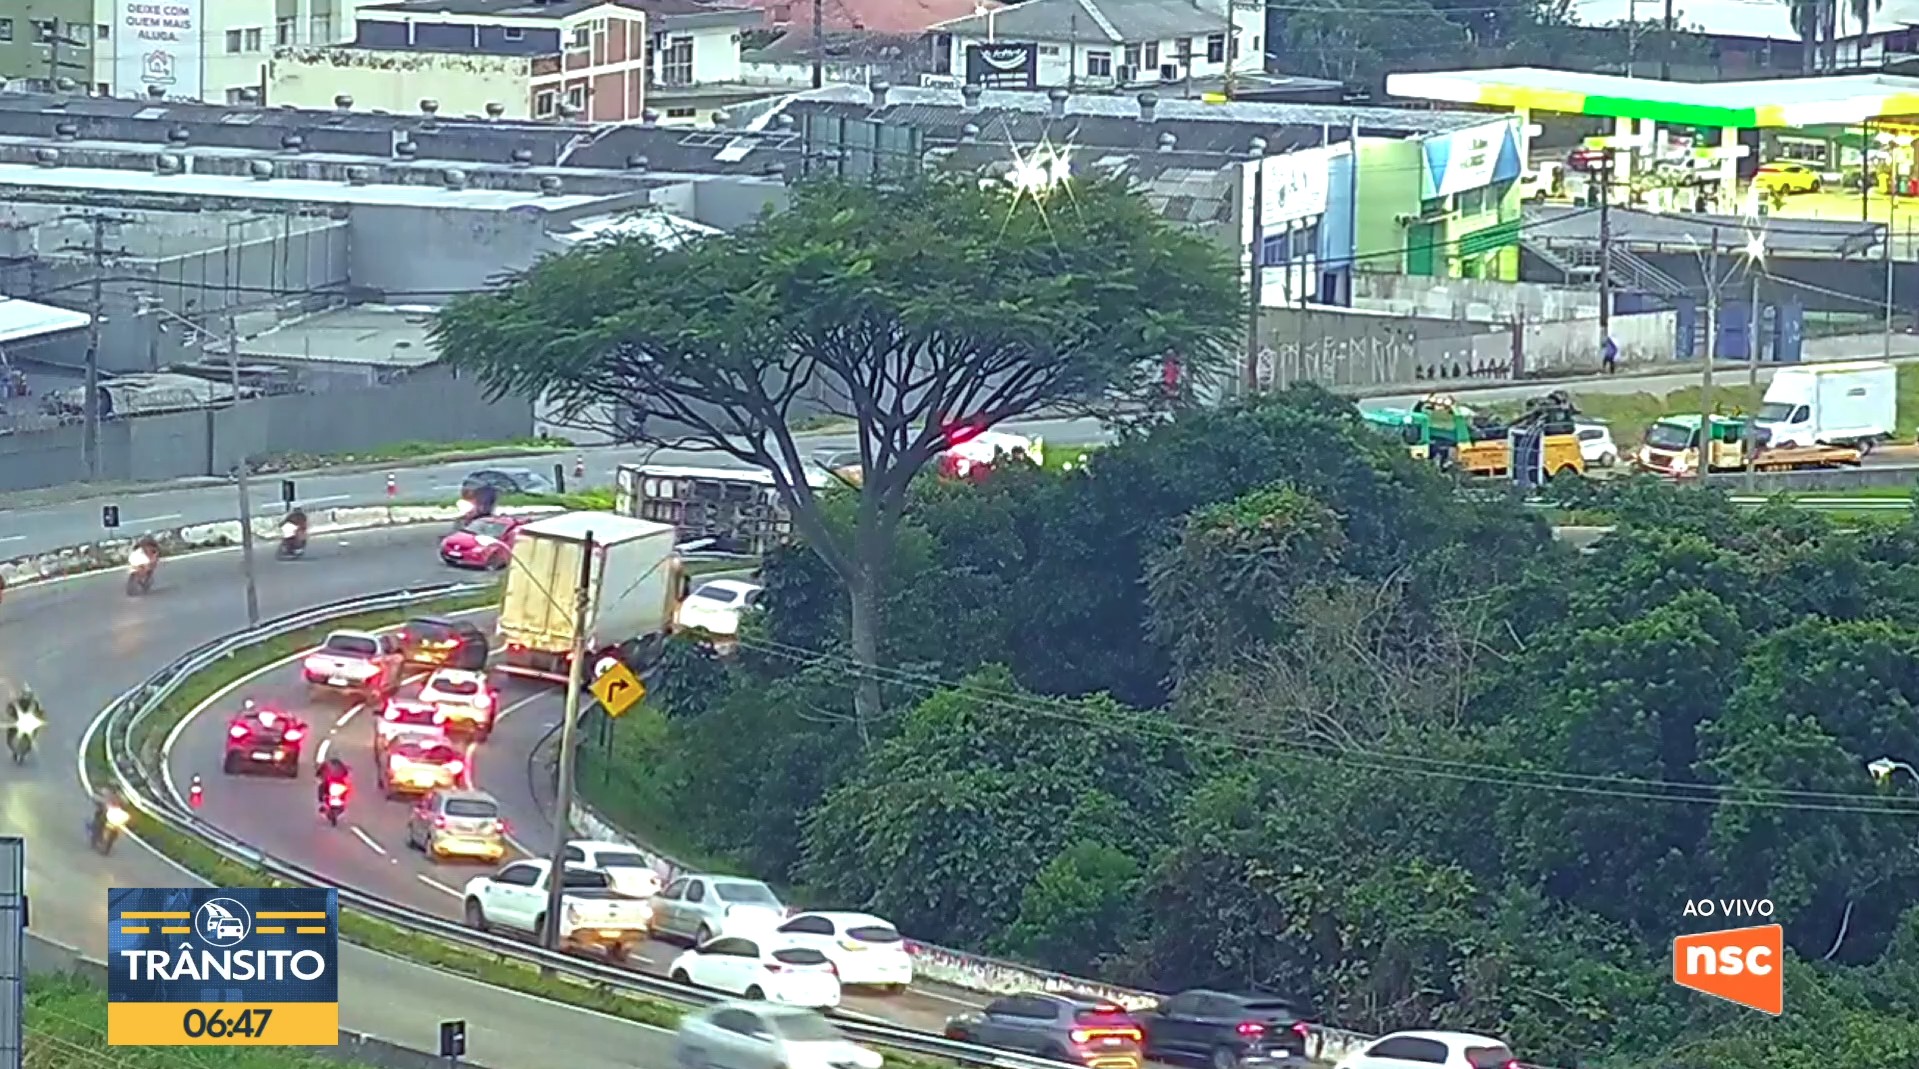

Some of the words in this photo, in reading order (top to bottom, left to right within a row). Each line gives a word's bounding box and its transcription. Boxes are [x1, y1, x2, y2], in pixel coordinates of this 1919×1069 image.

[127, 3, 161, 15] DEIXE
[163, 6, 189, 16] COM
[126, 16, 160, 27] QUEM
[162, 19, 191, 29] MAIS
[138, 30, 180, 41] ALUGA.
